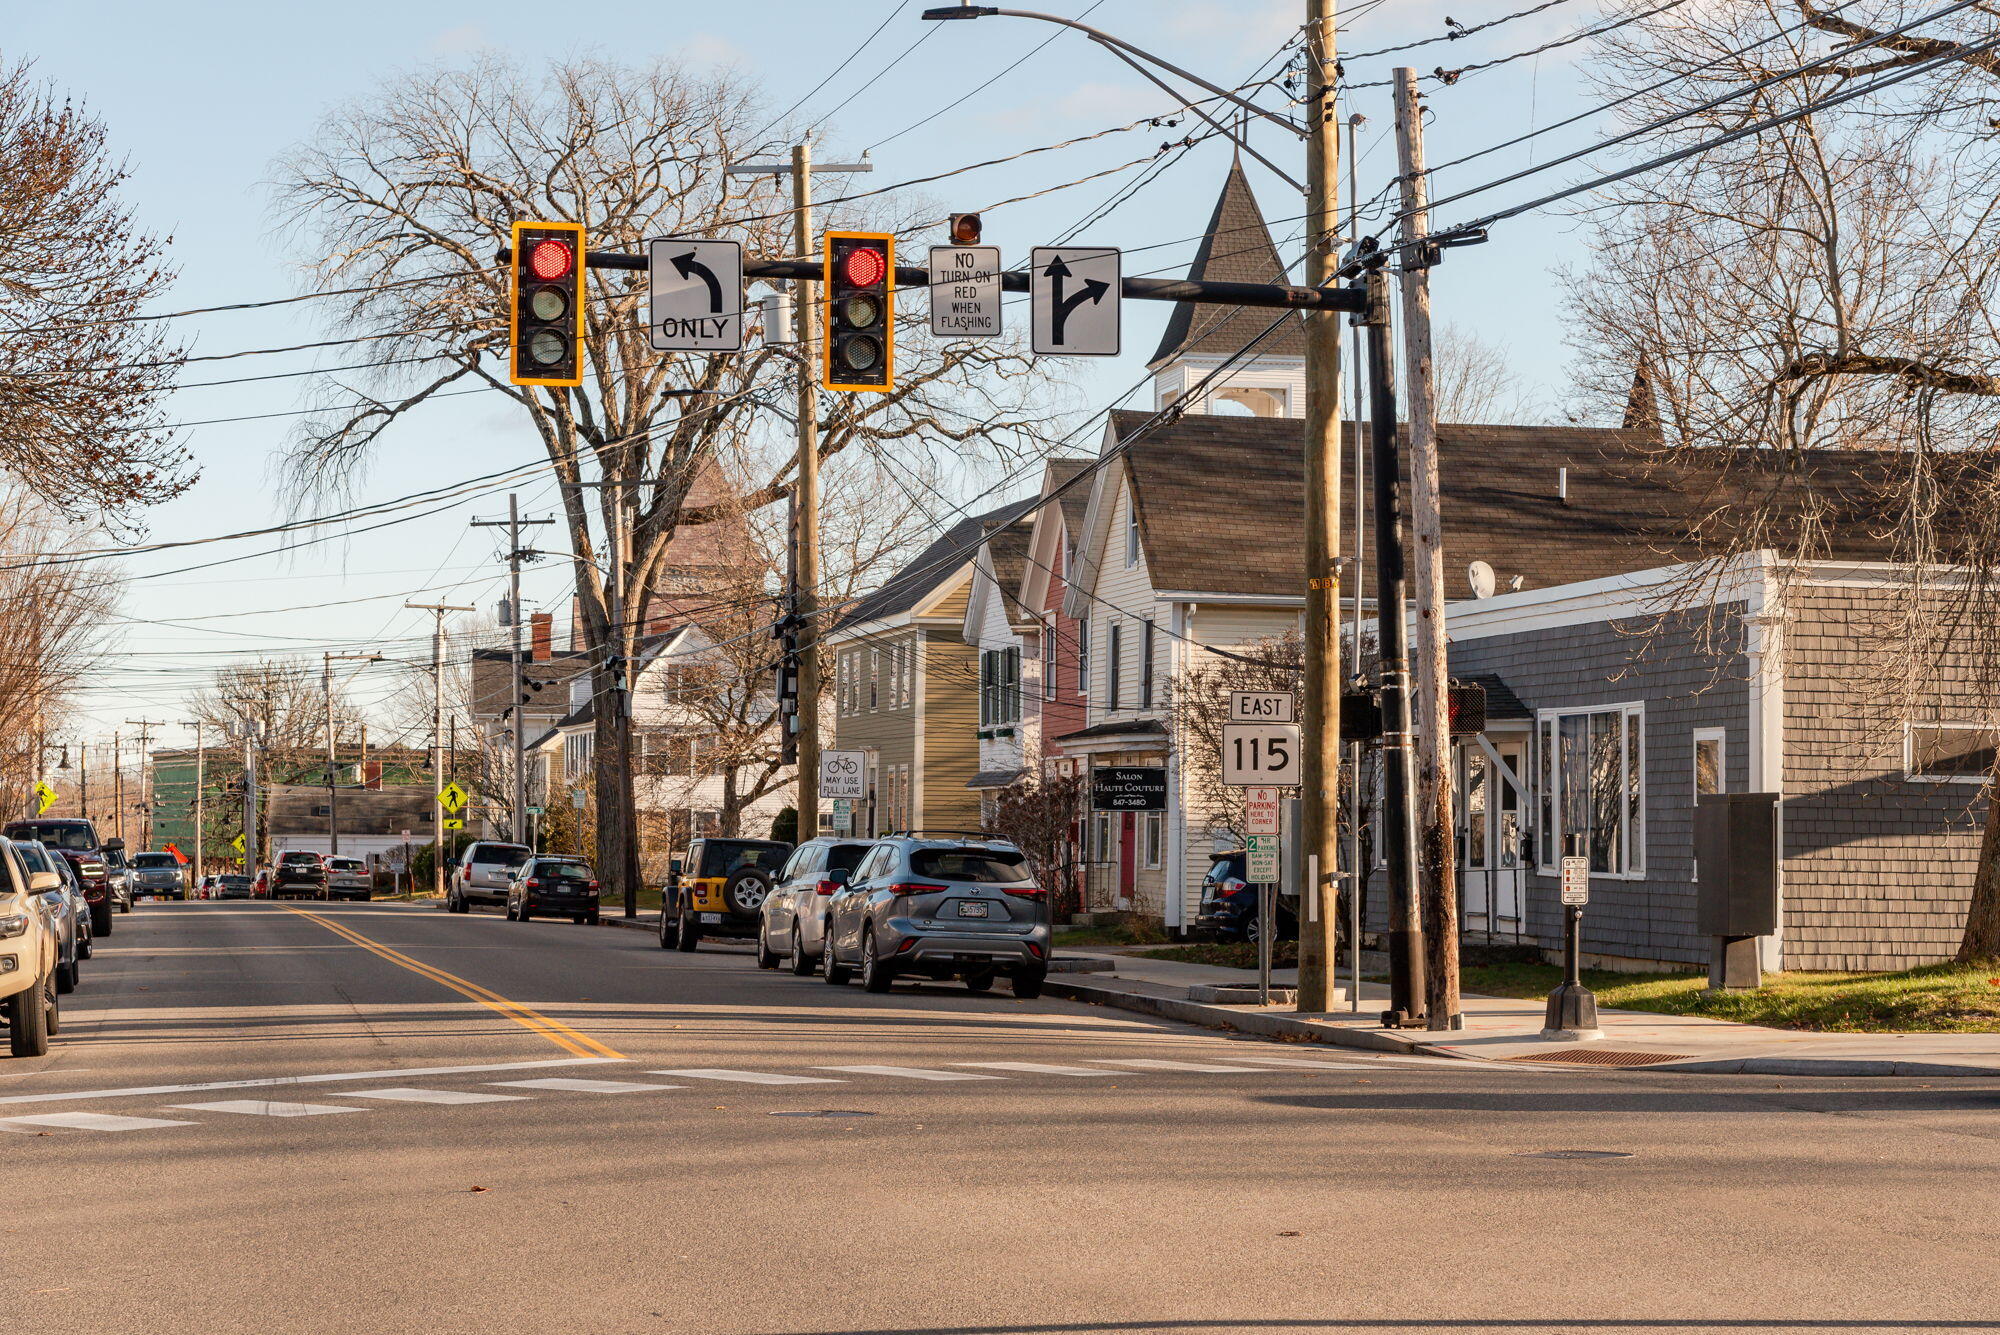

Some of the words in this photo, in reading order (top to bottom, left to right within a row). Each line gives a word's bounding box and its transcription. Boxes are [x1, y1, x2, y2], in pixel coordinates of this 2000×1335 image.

[955, 252, 975, 269] NO
[940, 270, 970, 284] TURN
[975, 270, 991, 284] ON
[954, 286, 977, 299] RED
[951, 302, 981, 314] WHEN
[662, 317, 729, 338] ONLY
[941, 316, 992, 328] FLASHING
[1241, 696, 1282, 716] EAST
[1233, 737, 1289, 771] 115
[825, 776, 841, 784] MAY
[844, 776, 859, 785] USE
[823, 785, 839, 794] FULL
[842, 786, 860, 795] LANE
[1257, 791, 1268, 801] NO
[1248, 801, 1276, 810] PARKING
[1248, 837, 1257, 851] 2
